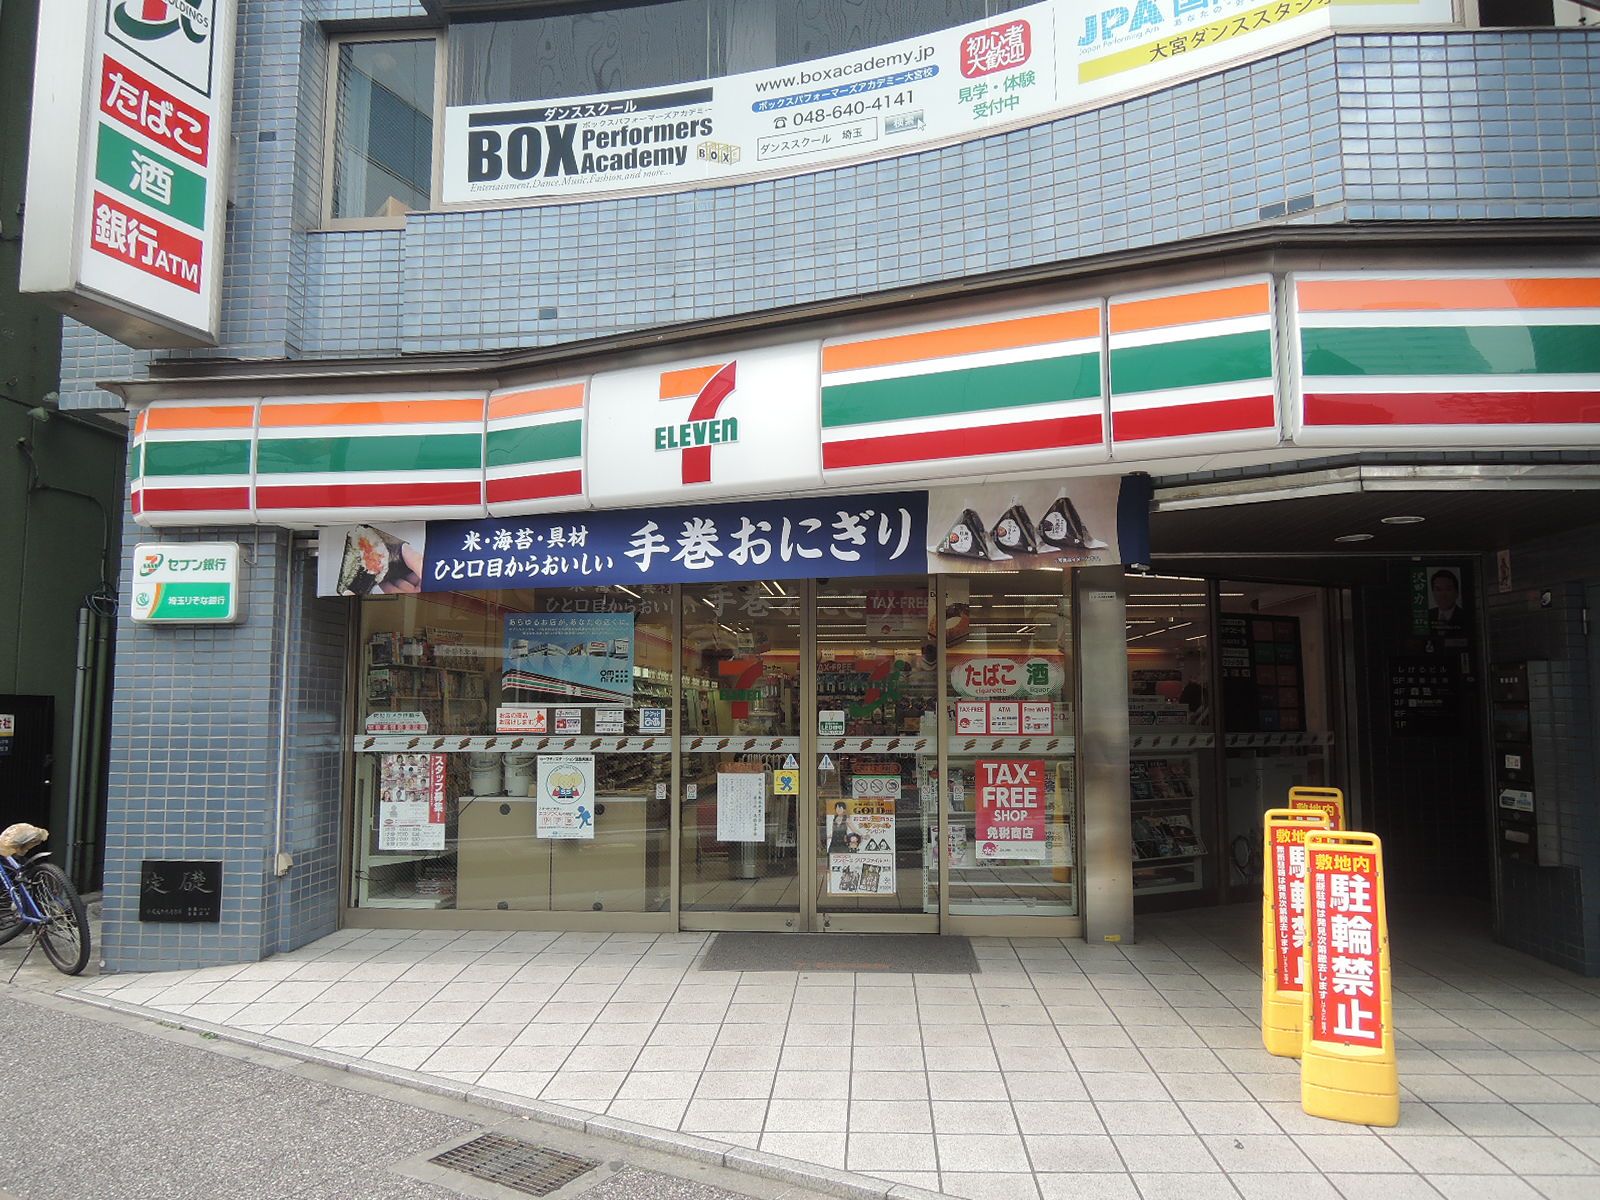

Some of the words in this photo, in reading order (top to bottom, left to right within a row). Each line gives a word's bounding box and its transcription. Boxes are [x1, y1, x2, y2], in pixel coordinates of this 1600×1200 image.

[1077, 0, 1165, 46] JPA
[967, 24, 1025, 56] 初心者
[755, 45, 935, 93] www.boxacademy.jp
[967, 44, 1026, 74] 大歓迎
[958, 70, 1036, 104] 見学・体験
[105, 72, 203, 155] たばこ
[544, 101, 637, 121] ダンススクール
[793, 90, 914, 126] 048-640-4141
[972, 95, 1020, 120] 受付中
[582, 116, 713, 150] Performers
[760, 134, 831, 155] ダンススクール
[842, 128, 863, 140] 埼玉
[468, 122, 577, 183] BOX
[581, 144, 688, 174] Academy
[129, 150, 175, 206] 酒
[95, 203, 199, 284] 銀行ATM
[462, 525, 588, 553] 米・海苔・具材
[623, 507, 912, 573] 手巻おにぎり
[168, 558, 227, 571] セブン銀行
[434, 553, 613, 581] ひと口目からおいしい
[168, 596, 225, 605] 埼玉りそな銀行
[965, 664, 1016, 687] たばこ
[1027, 663, 1049, 685] 酒
[983, 763, 1036, 785] TAX-
[983, 787, 1037, 808] FREE
[994, 810, 1028, 821] SHOP
[1315, 853, 1370, 873] 敷地内
[1329, 873, 1375, 1039] 駐輪禁止
